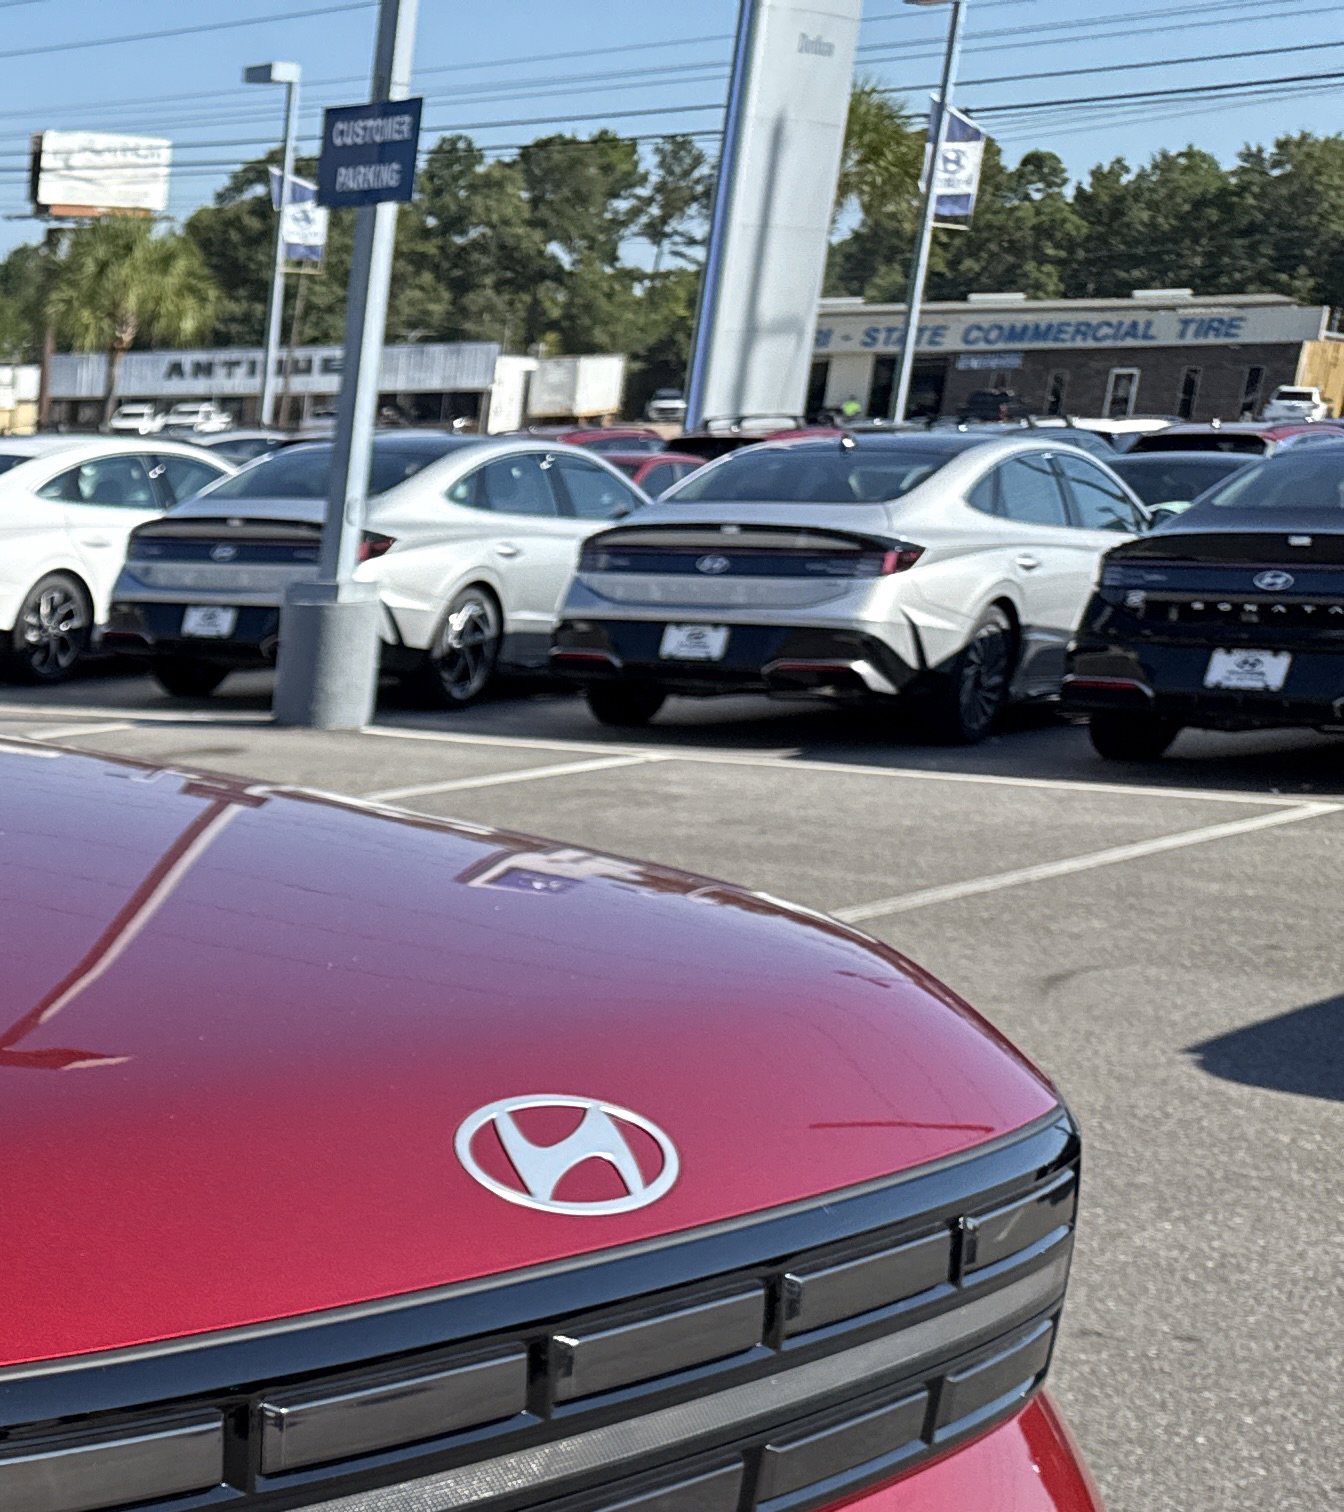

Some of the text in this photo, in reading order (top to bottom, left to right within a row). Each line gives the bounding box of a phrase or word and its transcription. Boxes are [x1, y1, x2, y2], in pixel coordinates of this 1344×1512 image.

[333, 114, 412, 147] CUSTOMER
[336, 162, 402, 192] PARKING
[963, 319, 1157, 346] COMMERCIAL
[1177, 316, 1247, 341] TIRE
[1191, 600, 1344, 615] SONATA
